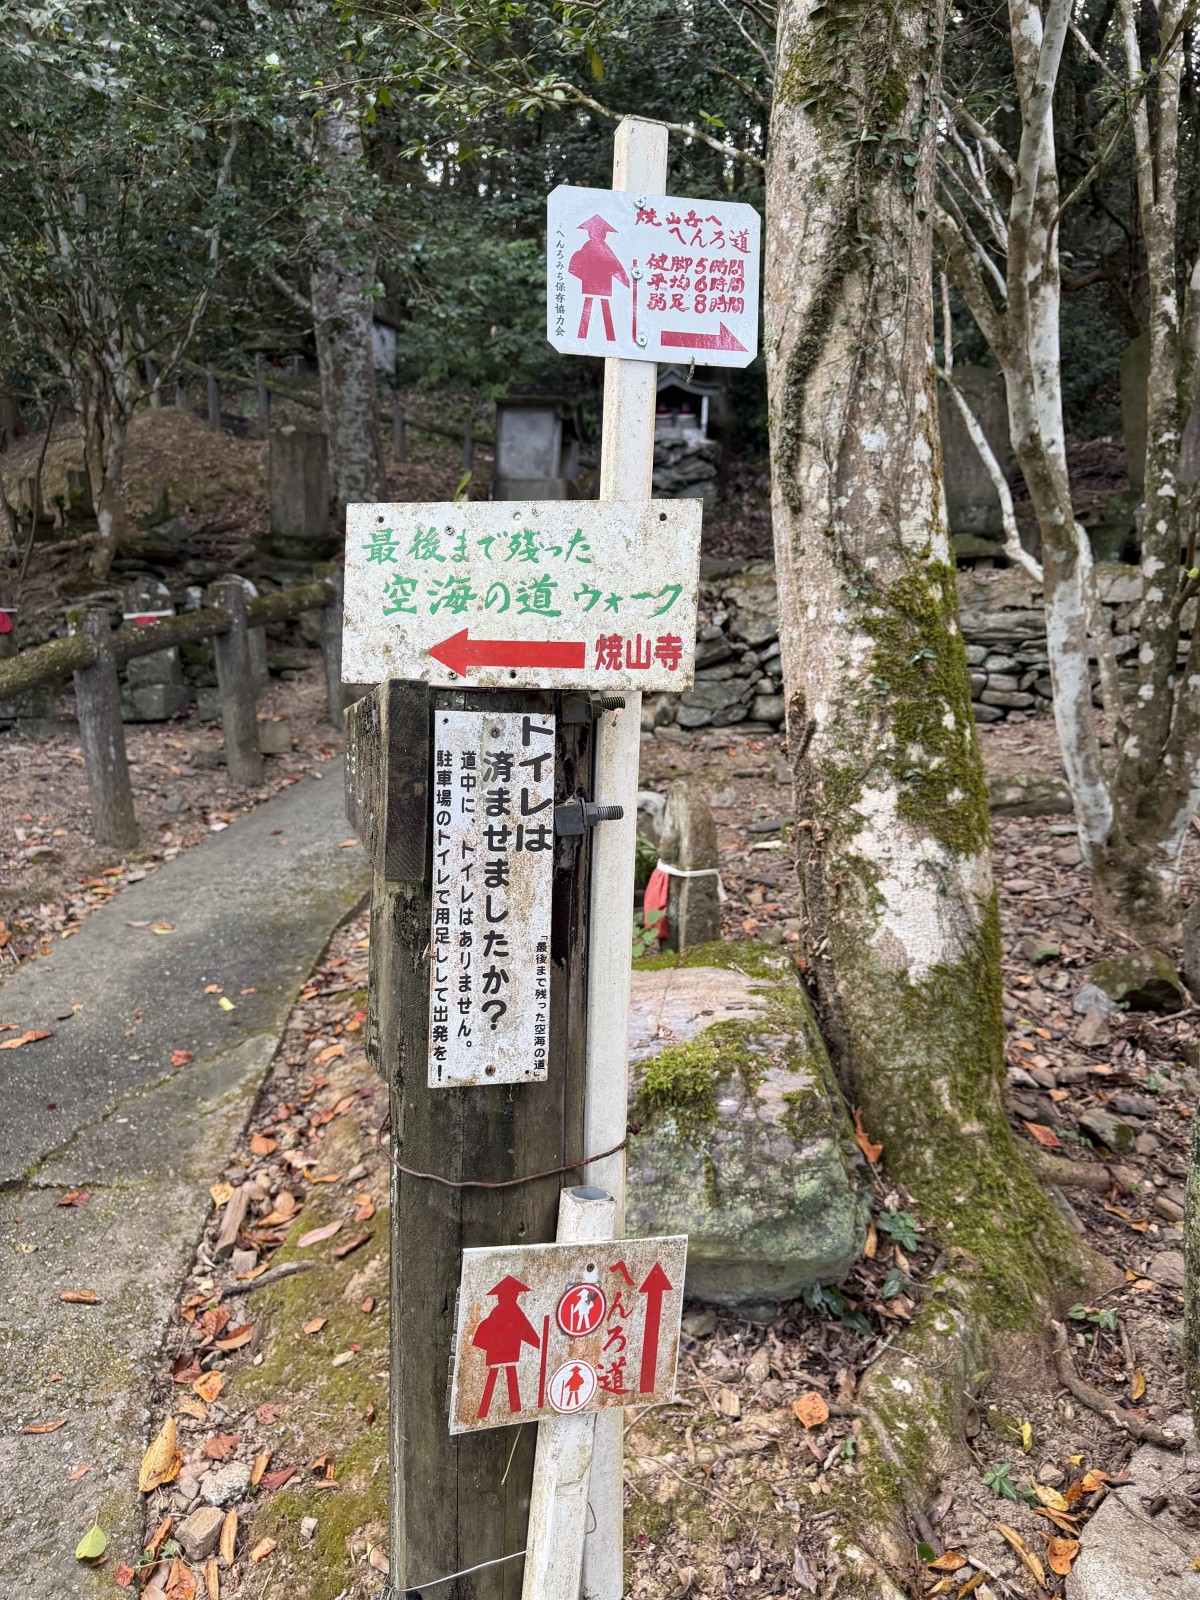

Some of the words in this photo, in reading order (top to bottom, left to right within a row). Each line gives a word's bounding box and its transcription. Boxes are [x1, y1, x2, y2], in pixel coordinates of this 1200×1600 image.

[668, 227, 751, 254] へんろ道
[555, 230, 566, 337] へんろみち保存協力会
[647, 273, 745, 293] 平均6時間
[361, 526, 593, 565] 最後まで残った
[595, 632, 683, 671] 焼山寺
[515, 716, 554, 852] トイレは
[481, 751, 515, 1030] 済ませましたか？
[597, 1260, 636, 1395] へんろ道
